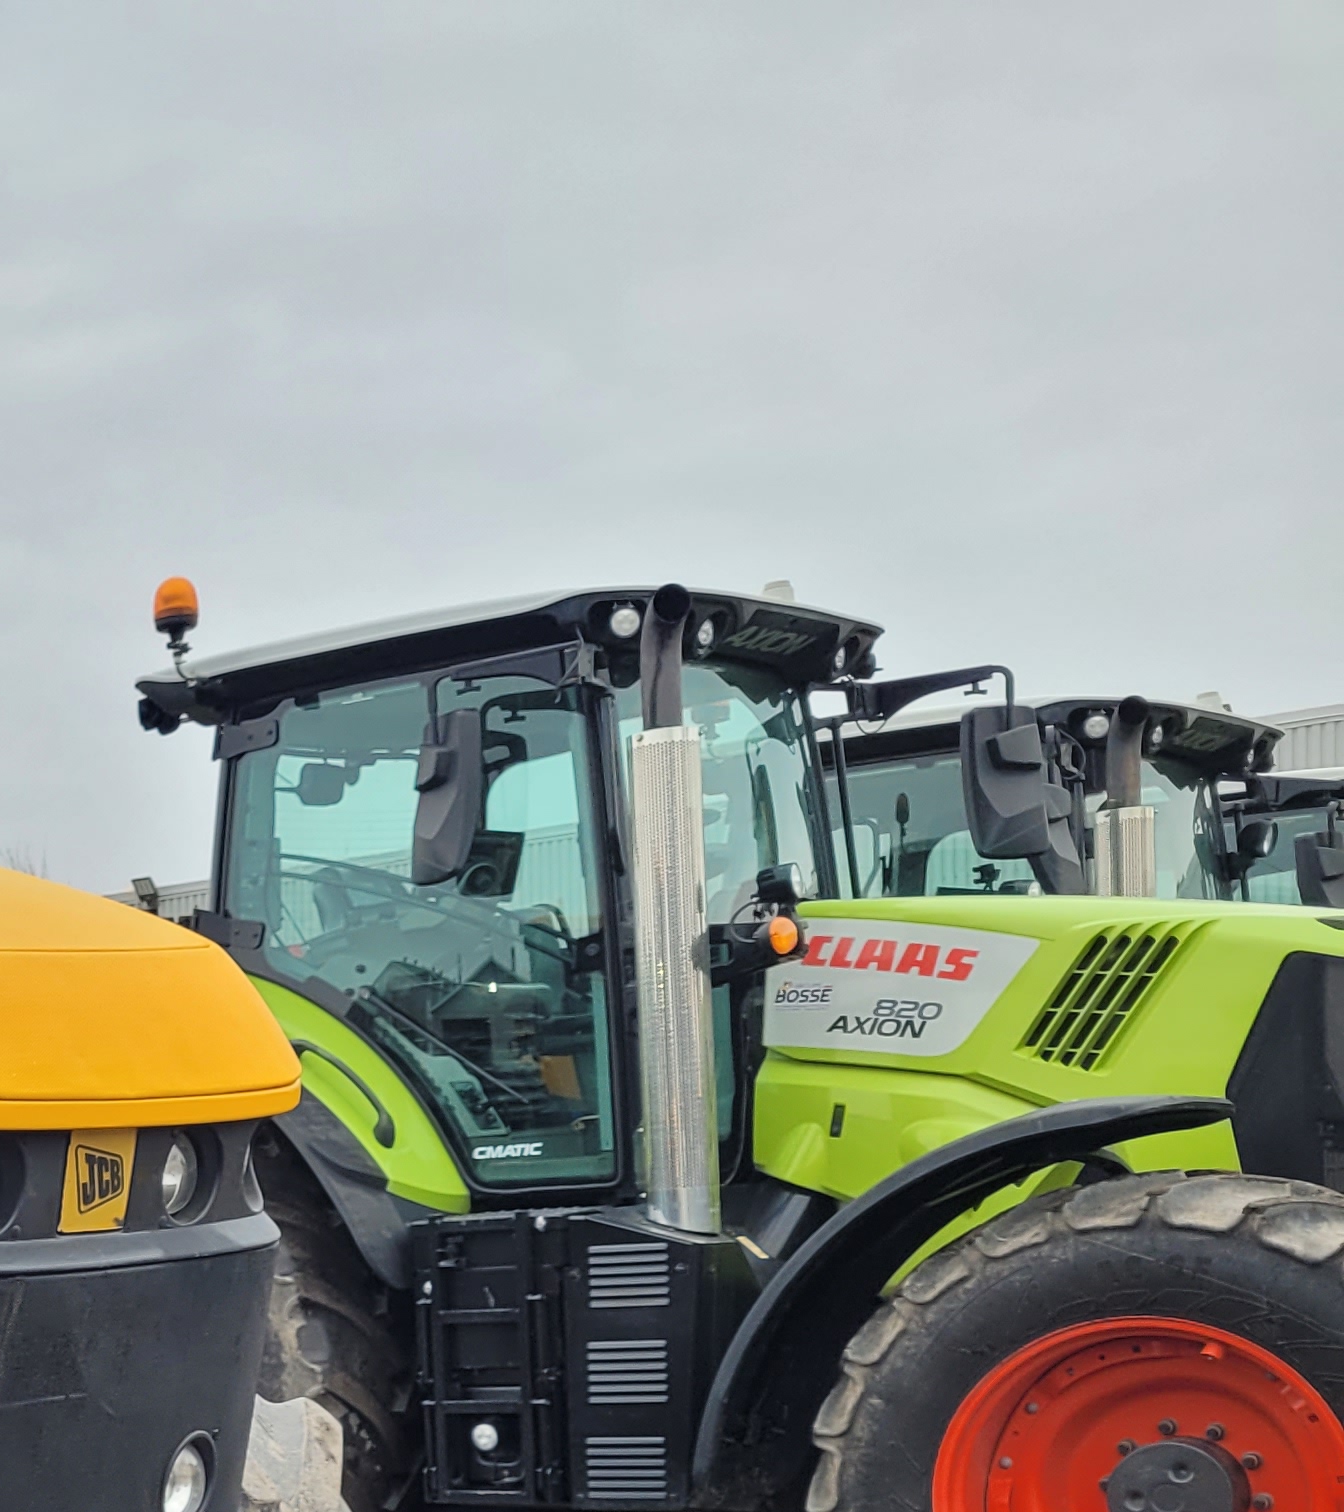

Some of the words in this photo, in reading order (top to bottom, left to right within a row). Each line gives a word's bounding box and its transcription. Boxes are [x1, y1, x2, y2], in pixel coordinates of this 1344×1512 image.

[801, 935, 980, 981] CLAAS
[872, 999, 943, 1020] 820
[827, 1015, 927, 1039] AXION
[472, 1142, 544, 1159] CMATIC
[81, 1152, 122, 1207] JCB
